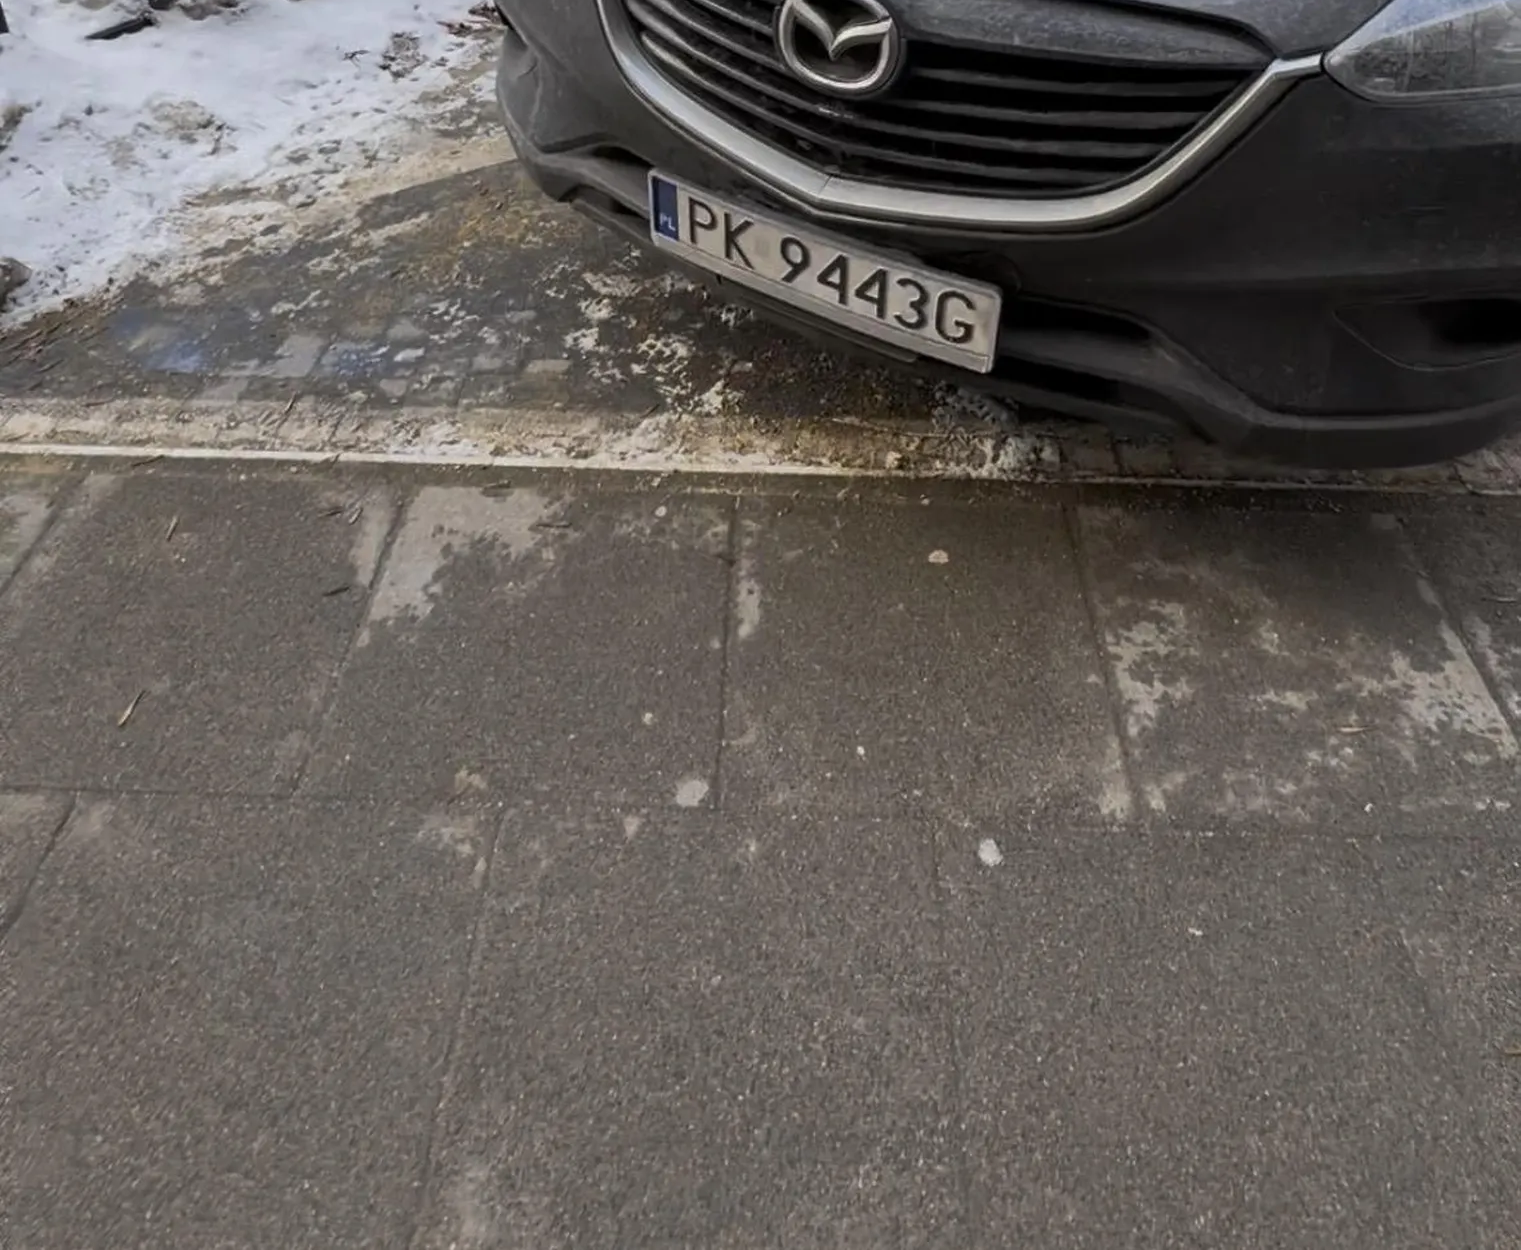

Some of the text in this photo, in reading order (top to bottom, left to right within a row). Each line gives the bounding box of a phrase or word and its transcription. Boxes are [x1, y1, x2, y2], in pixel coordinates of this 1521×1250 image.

[660, 212, 676, 231] PL
[688, 196, 977, 344] PK 9443G
